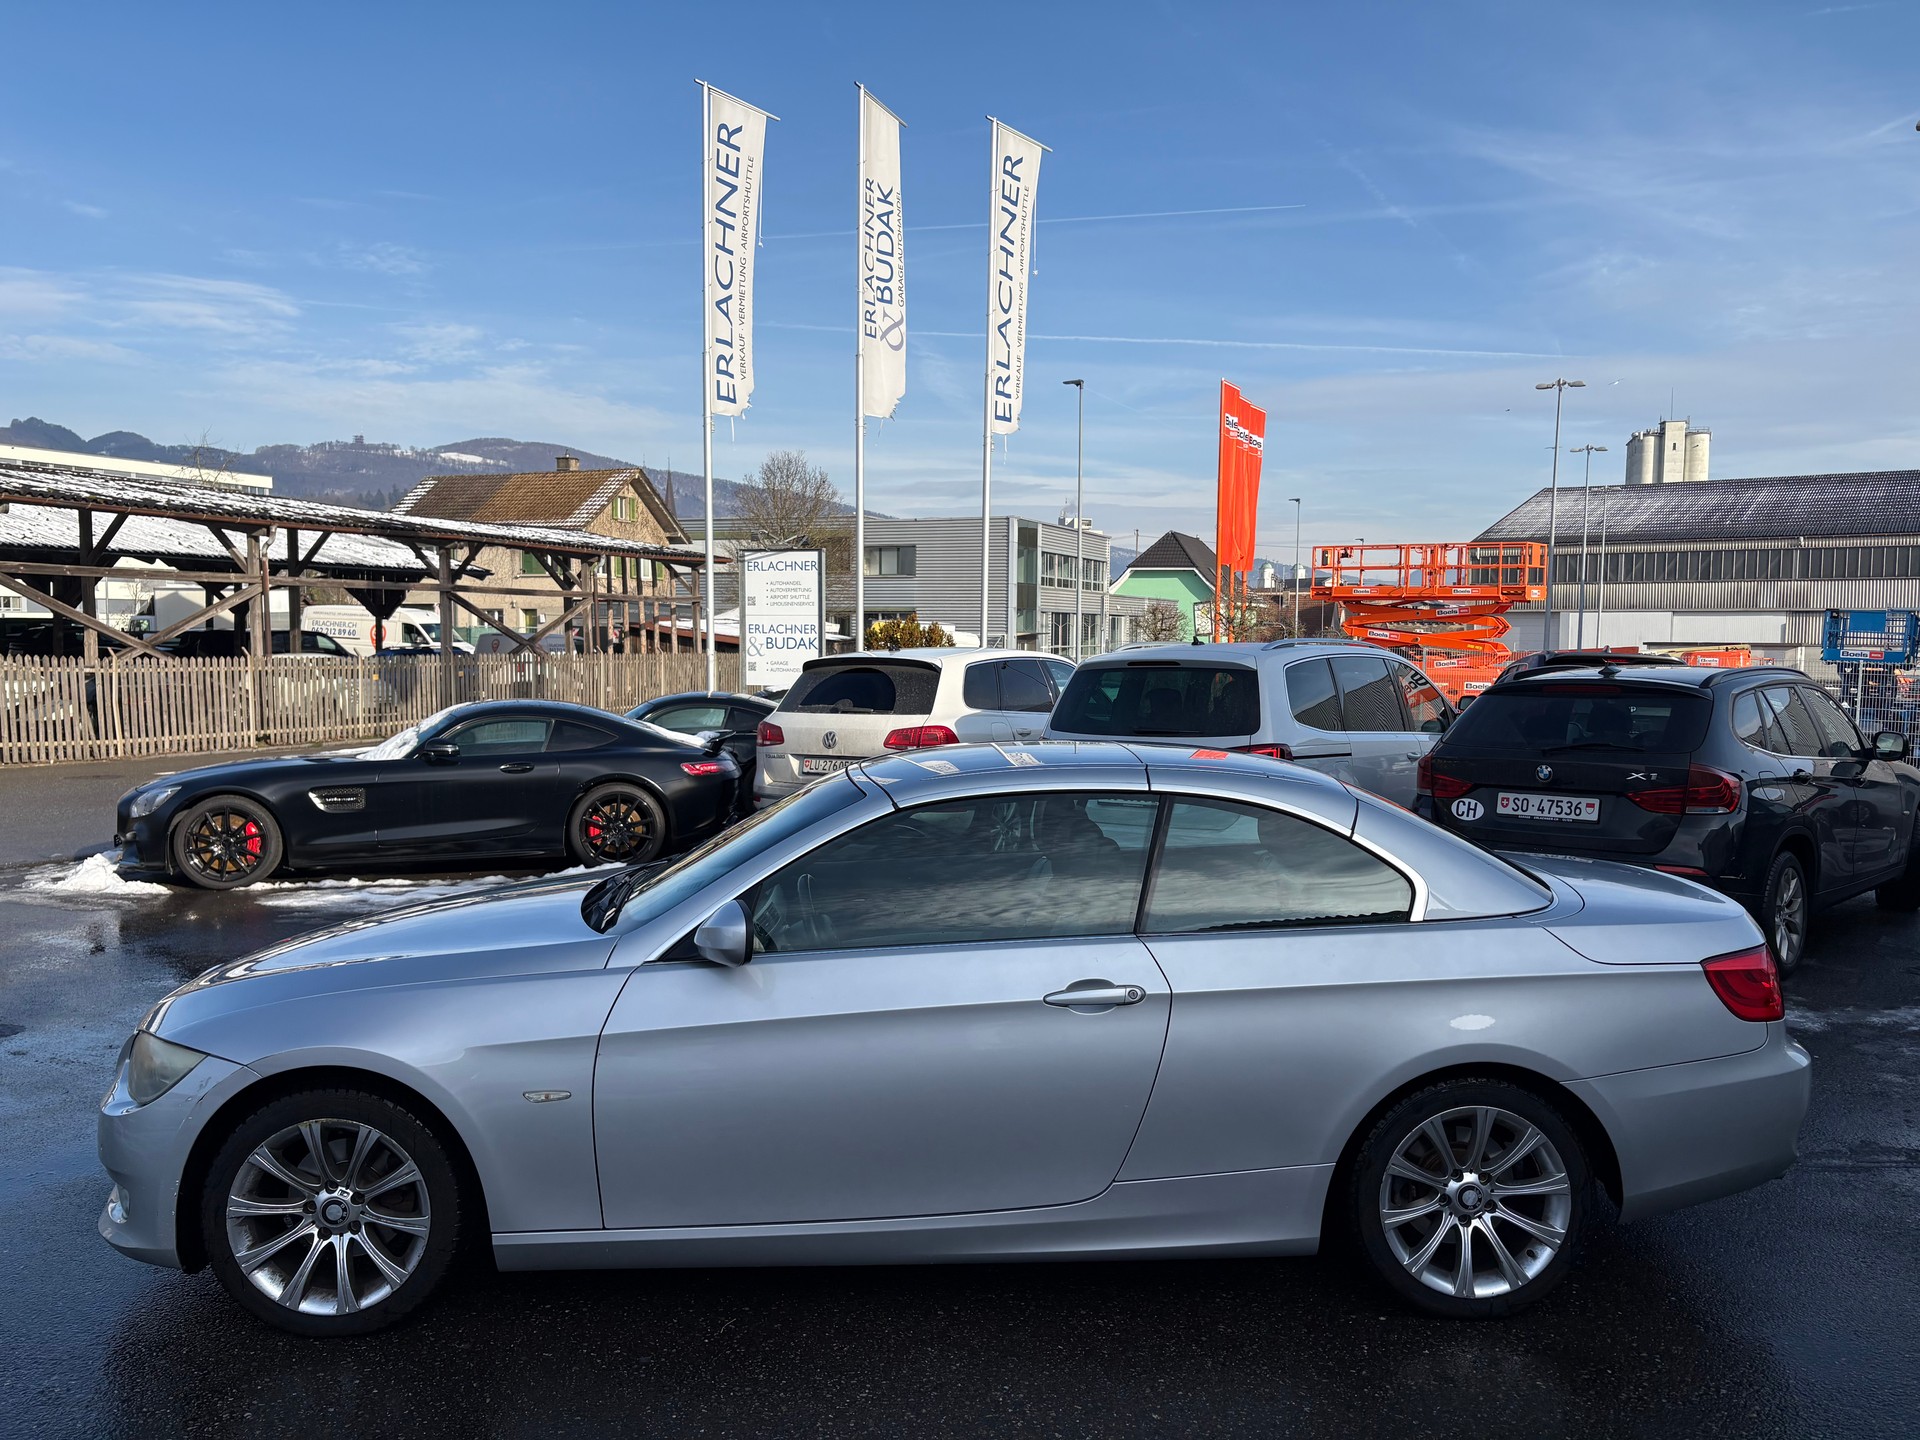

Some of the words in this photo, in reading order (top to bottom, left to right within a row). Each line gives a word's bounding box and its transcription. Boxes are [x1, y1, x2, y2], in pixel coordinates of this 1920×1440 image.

[740, 156, 755, 250] AIRPORTSHUTTLE
[876, 182, 894, 305] BUDAK
[1019, 185, 1029, 275] AIRPORTSHUTTLE
[715, 123, 743, 404] ERLACHNER
[864, 177, 876, 339] ERLACHNER
[738, 256, 747, 326] VERMIETUNG
[995, 155, 1023, 423] ERLACHNER
[878, 307, 904, 351] &
[739, 333, 747, 381] VERKAUF
[747, 561, 818, 571] ERLACHNER
[311, 620, 358, 628] ERLACHNER.CH
[747, 636, 765, 657] &
[766, 637, 818, 650] BUDAK
[748, 624, 817, 634] ERLACHNER
[1368, 630, 1388, 638] Boels
[1455, 800, 1478, 818] CH
